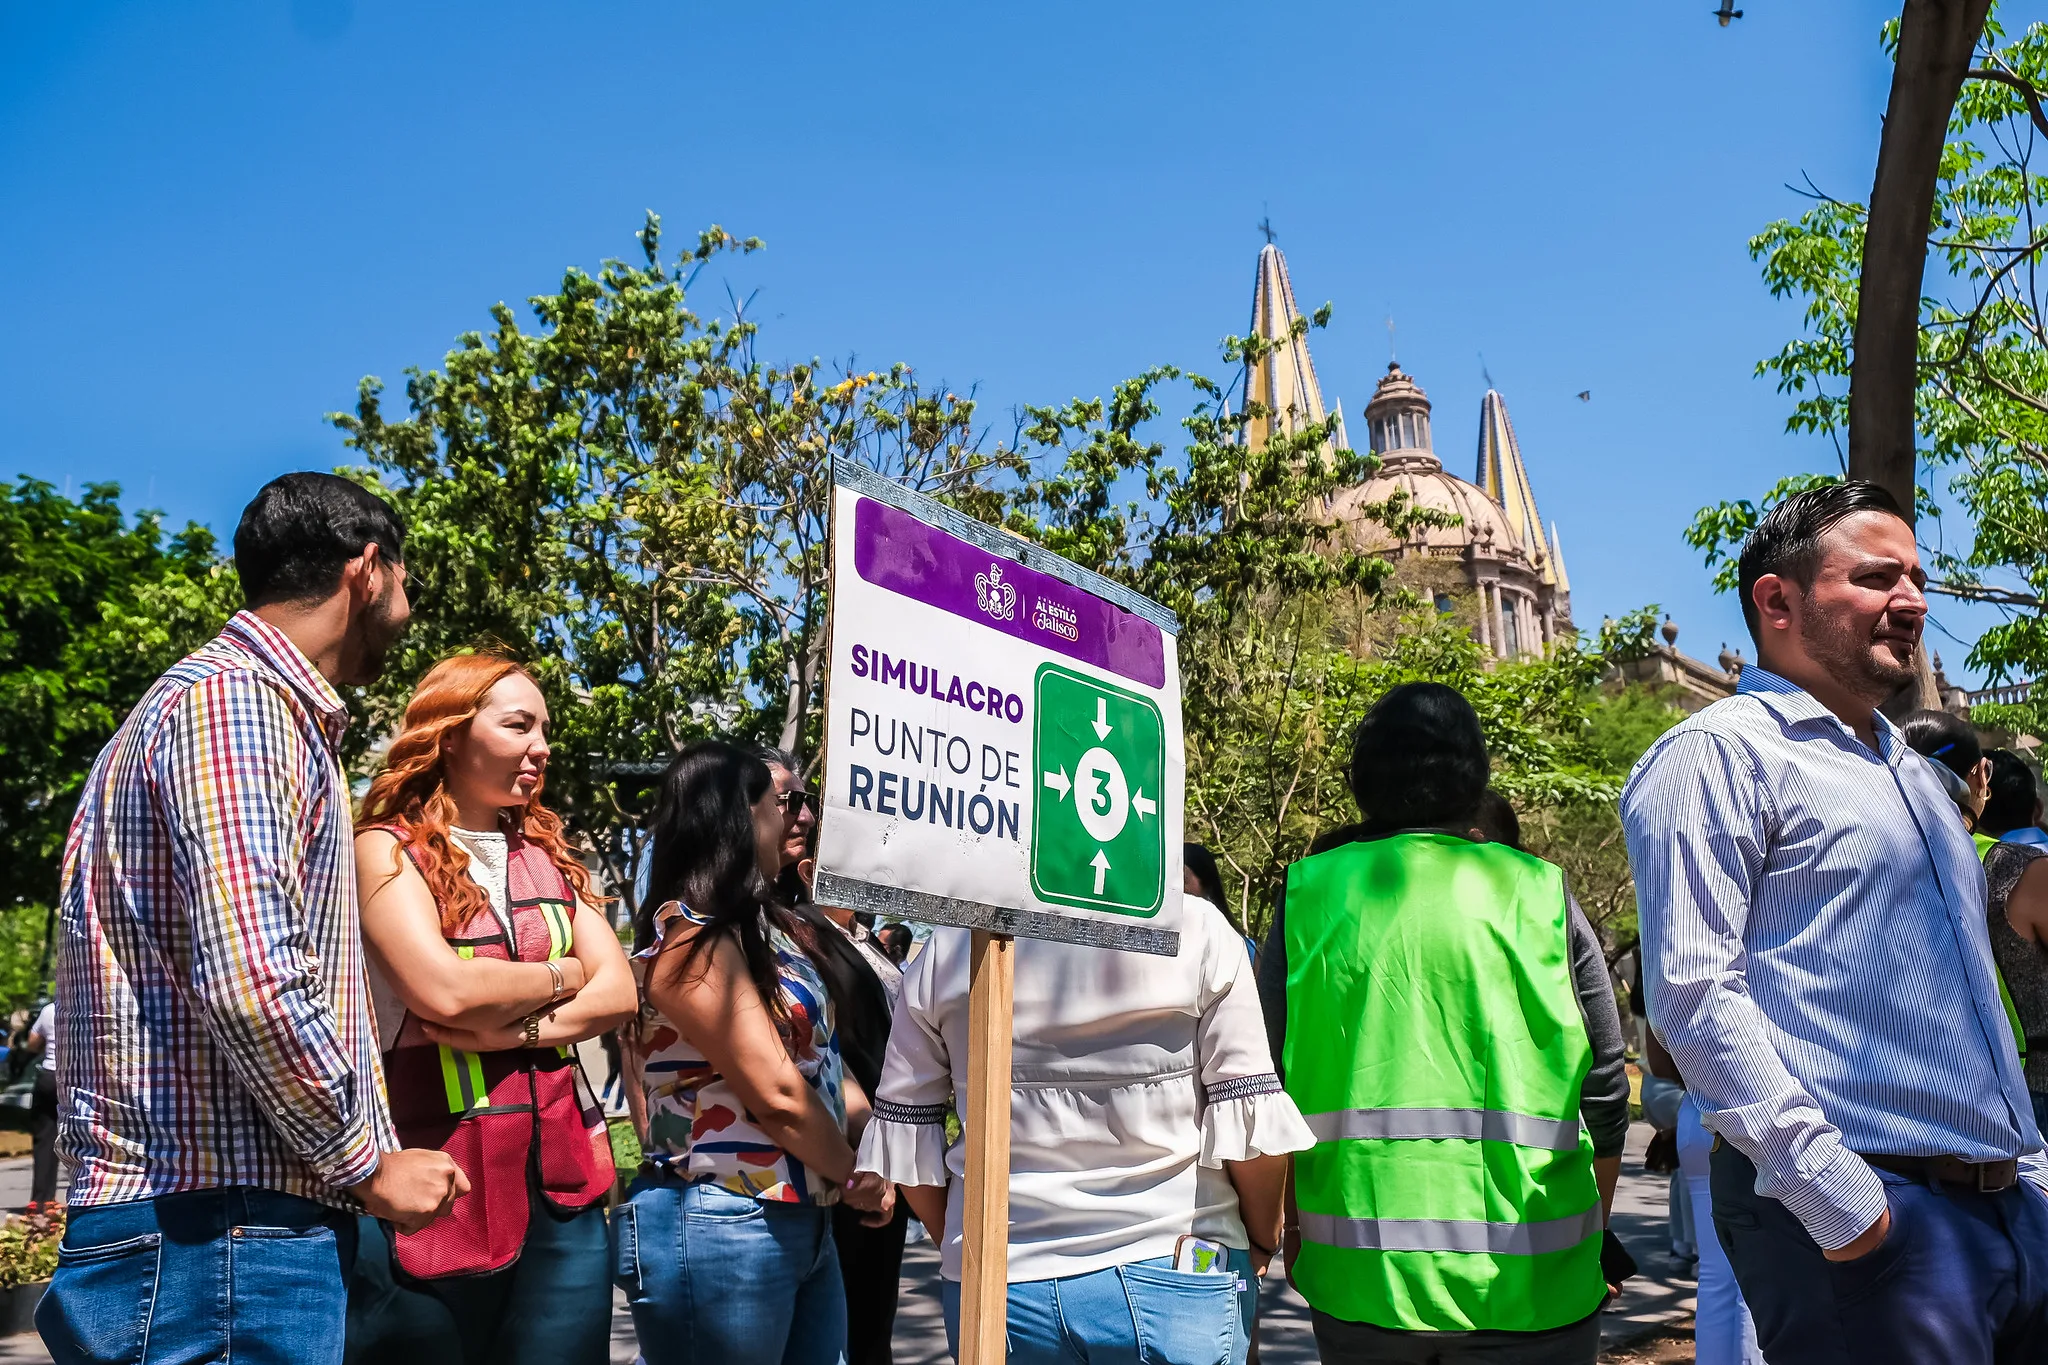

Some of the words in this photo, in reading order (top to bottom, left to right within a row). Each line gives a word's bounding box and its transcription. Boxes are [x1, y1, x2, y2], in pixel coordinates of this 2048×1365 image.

[1035, 600, 1048, 613] AL
[1048, 604, 1077, 624] ESTILO
[1036, 613, 1076, 639] Jalisco
[850, 643, 1024, 724] SIMULACRO
[850, 707, 971, 775] PUNTO
[981, 743, 1020, 788] DE
[848, 763, 1020, 842] REUNIÓN
[1090, 767, 1111, 817] 3
